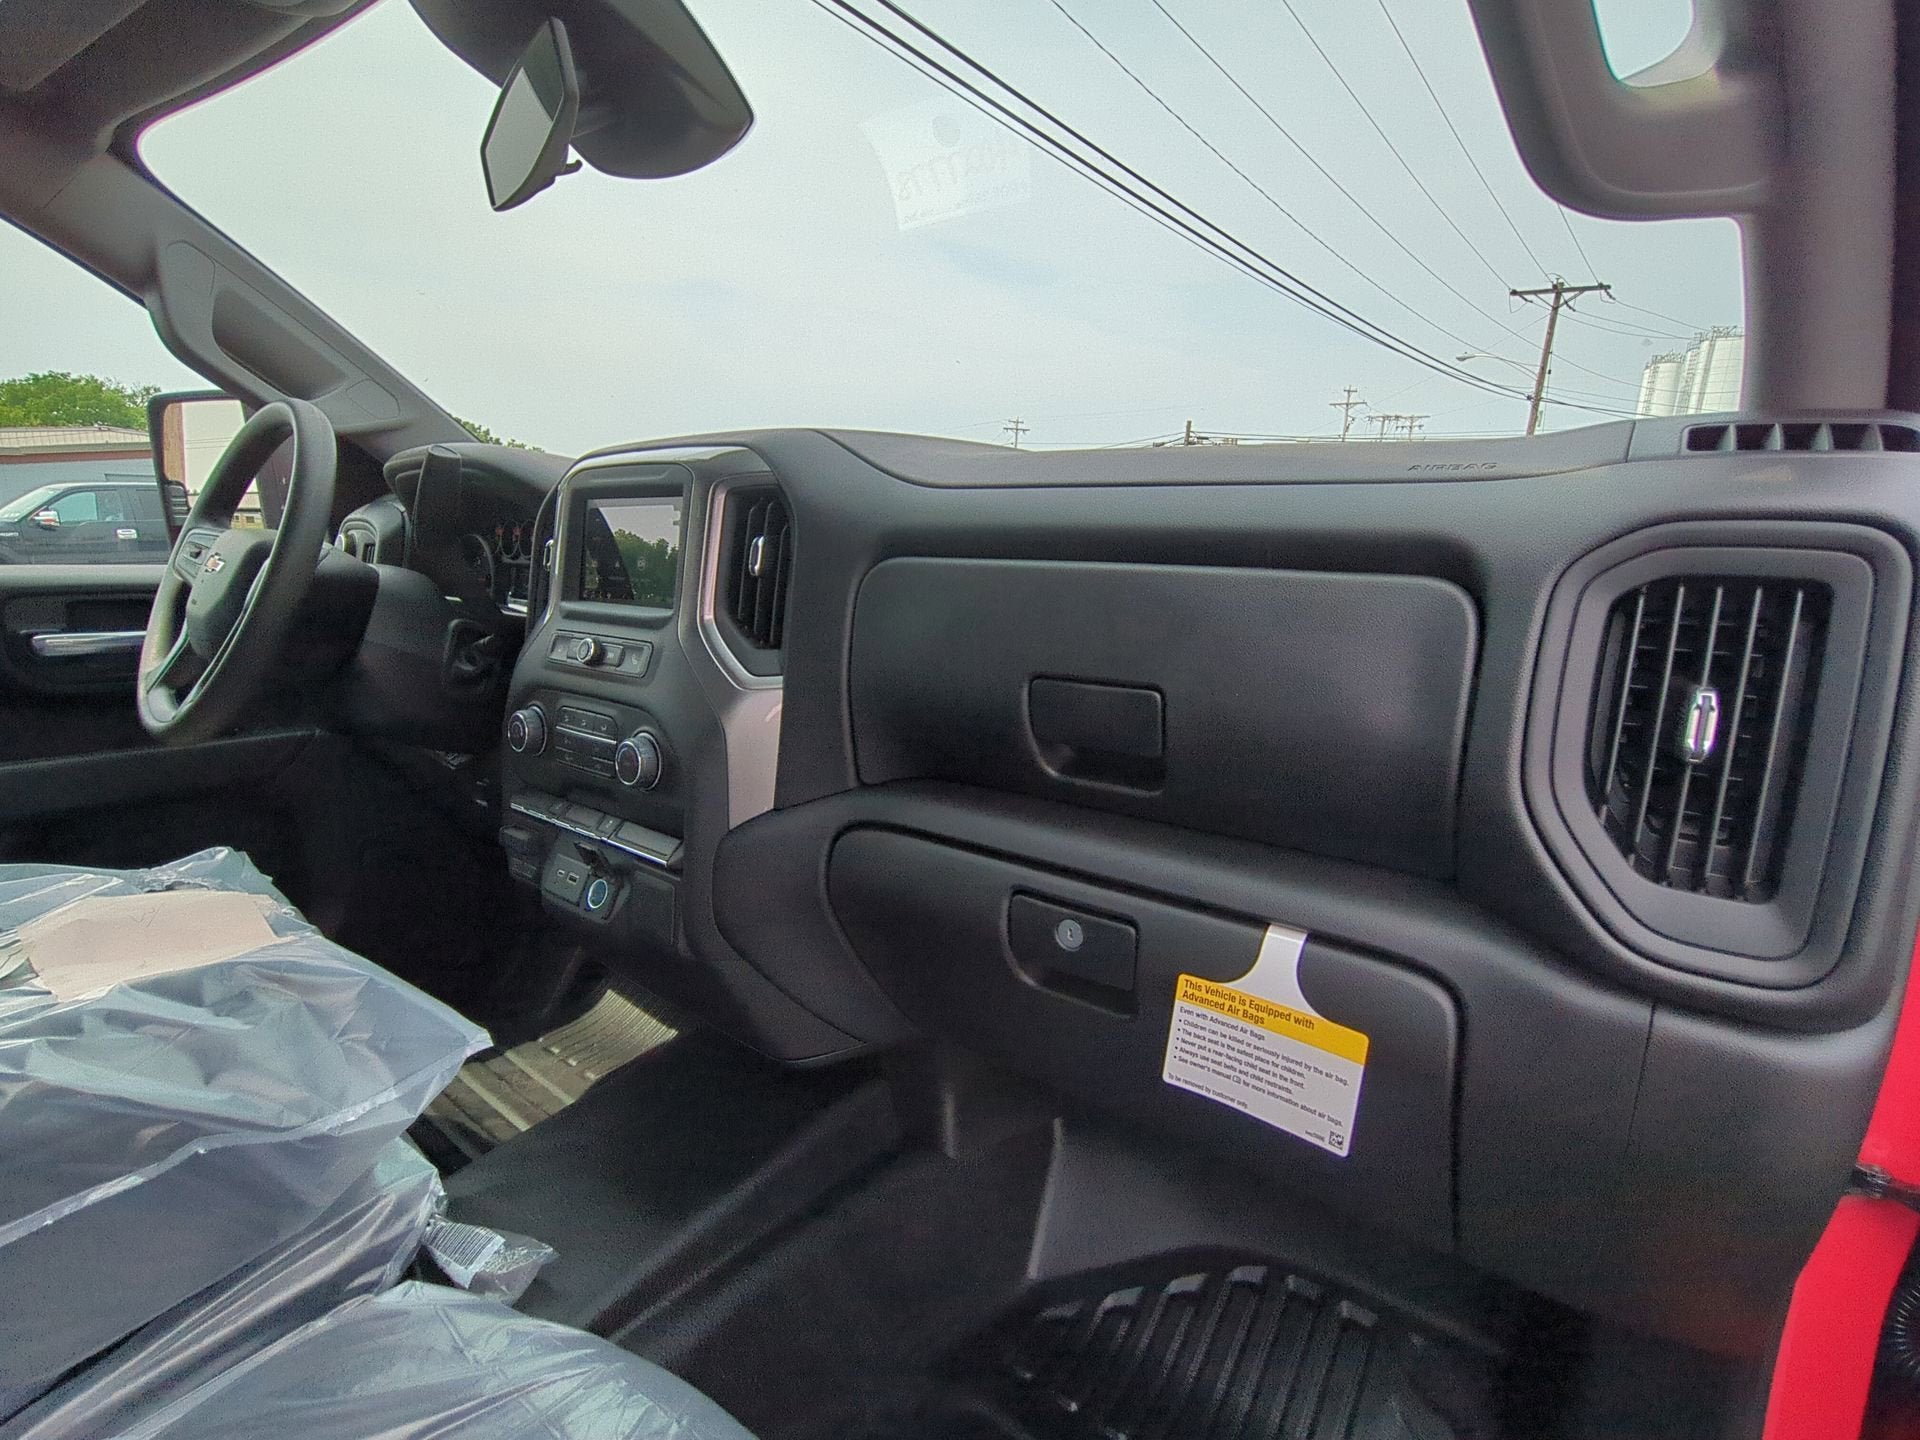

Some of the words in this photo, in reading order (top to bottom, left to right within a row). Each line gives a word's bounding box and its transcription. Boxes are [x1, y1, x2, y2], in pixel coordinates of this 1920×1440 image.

[1407, 462, 1497, 472] AIRBAG
[1180, 1006, 1194, 1016] Even
[1195, 1012, 1208, 1020] with
[1209, 1016, 1239, 1031] Advanced
[1239, 1026, 1248, 1034] Air
[1249, 1029, 1265, 1041] Bags
[1182, 990, 1226, 1011] Advanced
[1226, 1004, 1240, 1016] Air
[1242, 1008, 1265, 1025] Bags
[1184, 978, 1202, 992] This
[1205, 985, 1237, 1003] Vehicle
[1238, 995, 1247, 1007] is
[1248, 999, 1292, 1022] Equipped
[1294, 1016, 1315, 1030] with
[1179, 1046, 1199, 1058] Always
[1210, 1058, 1223, 1067] seat
[1223, 1062, 1237, 1073] belts
[1238, 1069, 1249, 1077] and
[1250, 1074, 1264, 1083] child
[1181, 1037, 1197, 1047] Never
[1197, 1044, 1207, 1052] put
[1212, 1049, 1243, 1066] rear-facing
[1244, 1061, 1258, 1071] child
[1258, 1067, 1271, 1076] seat
[1279, 1073, 1288, 1082] the
[1182, 1028, 1192, 1037] The
[1193, 1032, 1206, 1041] back
[1207, 1038, 1219, 1046] seat
[1226, 1044, 1236, 1052] the
[1236, 1048, 1254, 1059] safest
[1254, 1055, 1270, 1065] place
[1271, 1060, 1280, 1068] for
[1183, 1019, 1207, 1032] Children
[1208, 1028, 1218, 1036] can
[1220, 1031, 1227, 1039] be
[1228, 1034, 1245, 1045] killed
[1253, 1044, 1280, 1060] seriously
[1281, 1054, 1303, 1068] injured
[1304, 1062, 1312, 1072] by
[1313, 1066, 1324, 1076] the
[1178, 1056, 1188, 1064] See
[1189, 1060, 1210, 1072] owner's
[1211, 1069, 1232, 1080] manual
[1242, 1079, 1250, 1087] for
[1251, 1084, 1266, 1094] more
[1267, 1090, 1299, 1108] information
[1300, 1104, 1317, 1116] about
